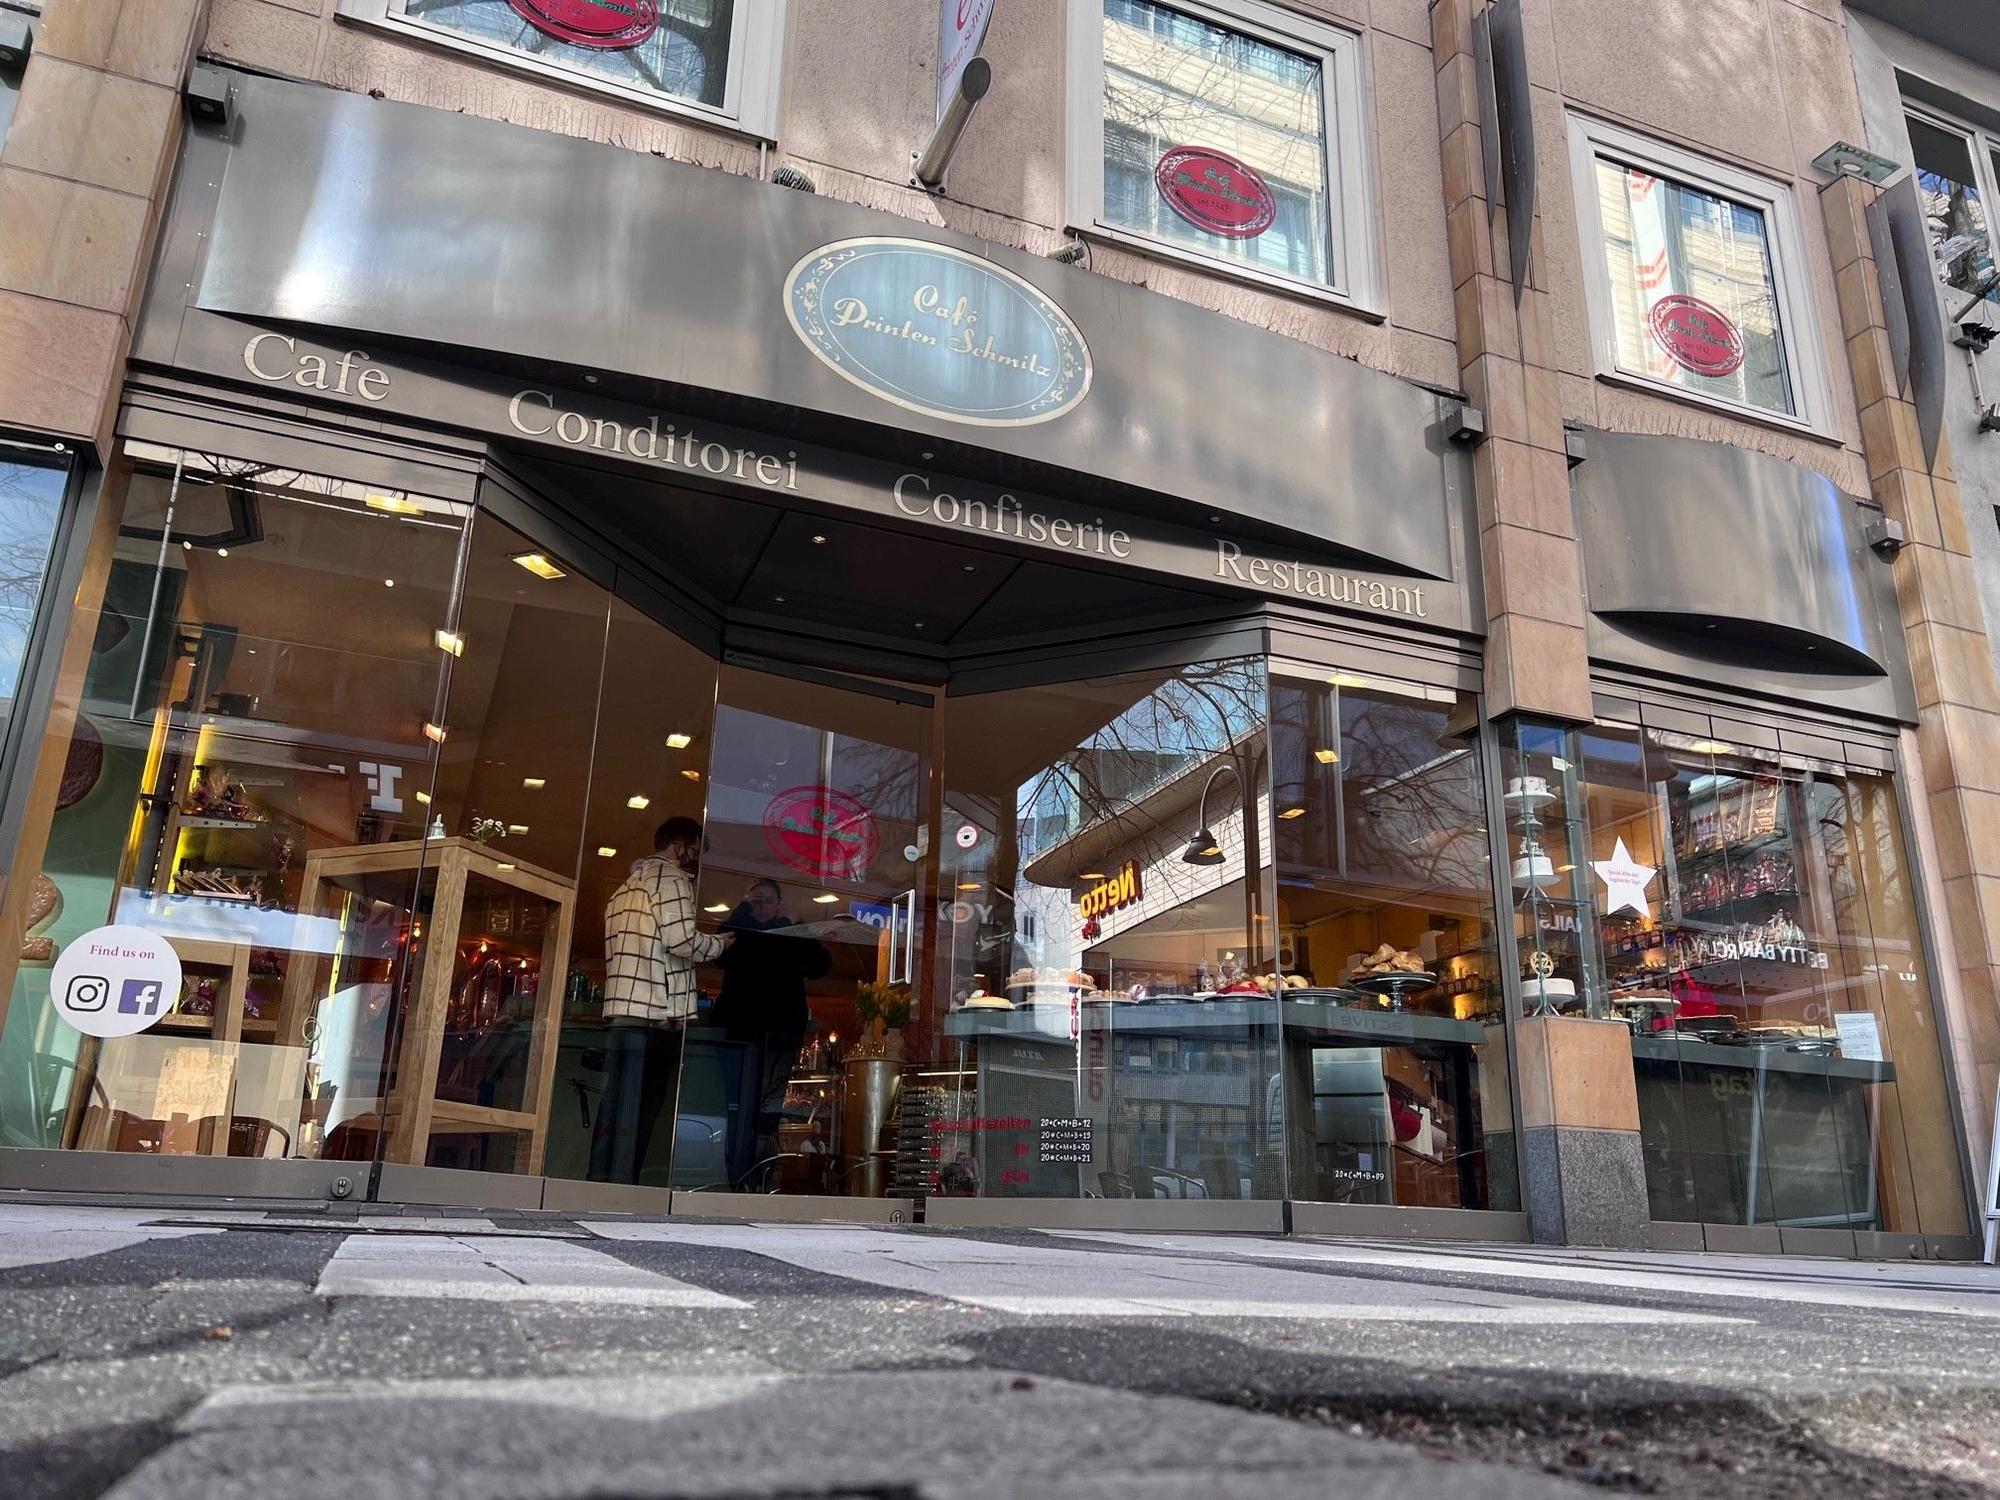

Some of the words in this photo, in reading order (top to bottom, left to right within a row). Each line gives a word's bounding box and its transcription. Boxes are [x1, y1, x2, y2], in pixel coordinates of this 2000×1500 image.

[913, 284, 977, 327] Café
[830, 297, 937, 346] Printen
[945, 327, 1051, 378] Schmitz
[243, 332, 390, 401] Cafe
[508, 389, 800, 491] Conditorei
[892, 473, 1132, 559] Confiserie
[1213, 539, 1429, 618] Restaurant
[90, 945, 119, 957] Find
[122, 950, 136, 958] us
[140, 951, 155, 959] on
